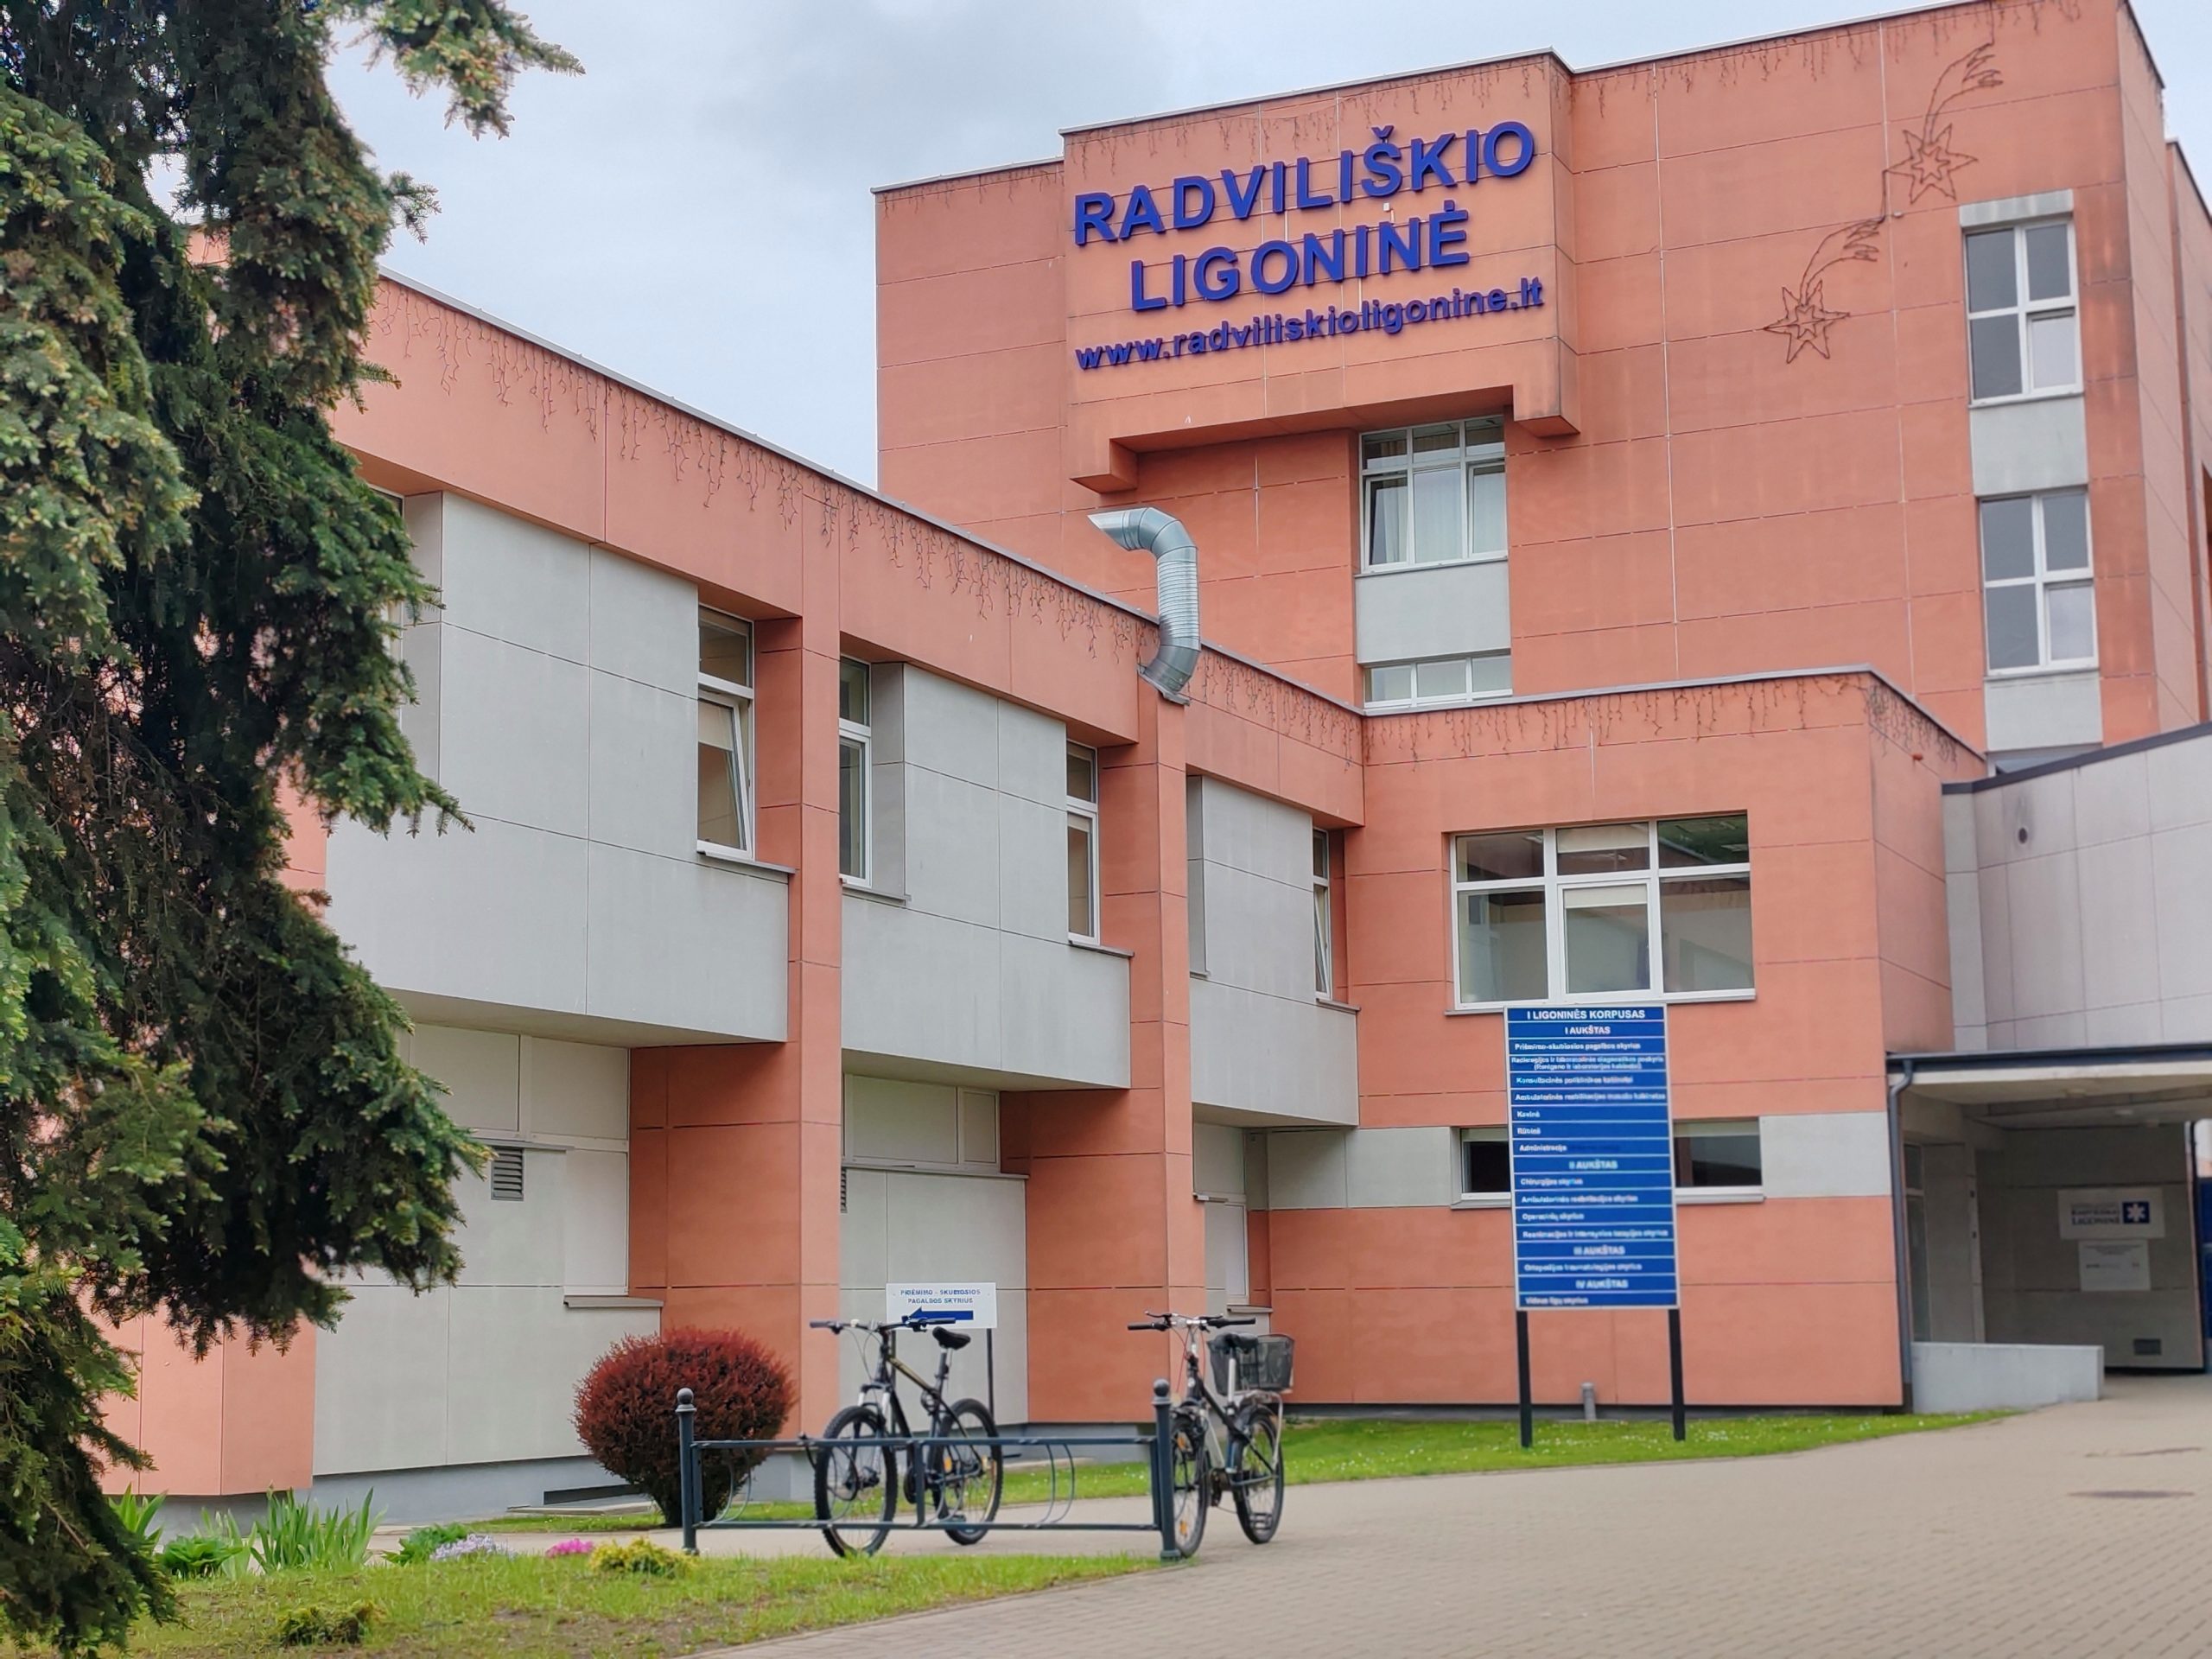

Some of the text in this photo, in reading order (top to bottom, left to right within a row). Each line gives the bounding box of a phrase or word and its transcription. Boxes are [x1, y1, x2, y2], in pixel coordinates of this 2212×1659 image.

[1073, 121, 1535, 245] RADVILIŠKIO
[1130, 200, 1470, 312] LIGONINĖ
[1075, 276, 1544, 370] www.radviliskioligonine.lt
[1527, 1009, 1645, 1020] I LIGONINĖS KORPUSAS
[1569, 1025, 1611, 1034] AUKŠTAS
[1576, 1159, 1618, 1170] AUKŠTAS
